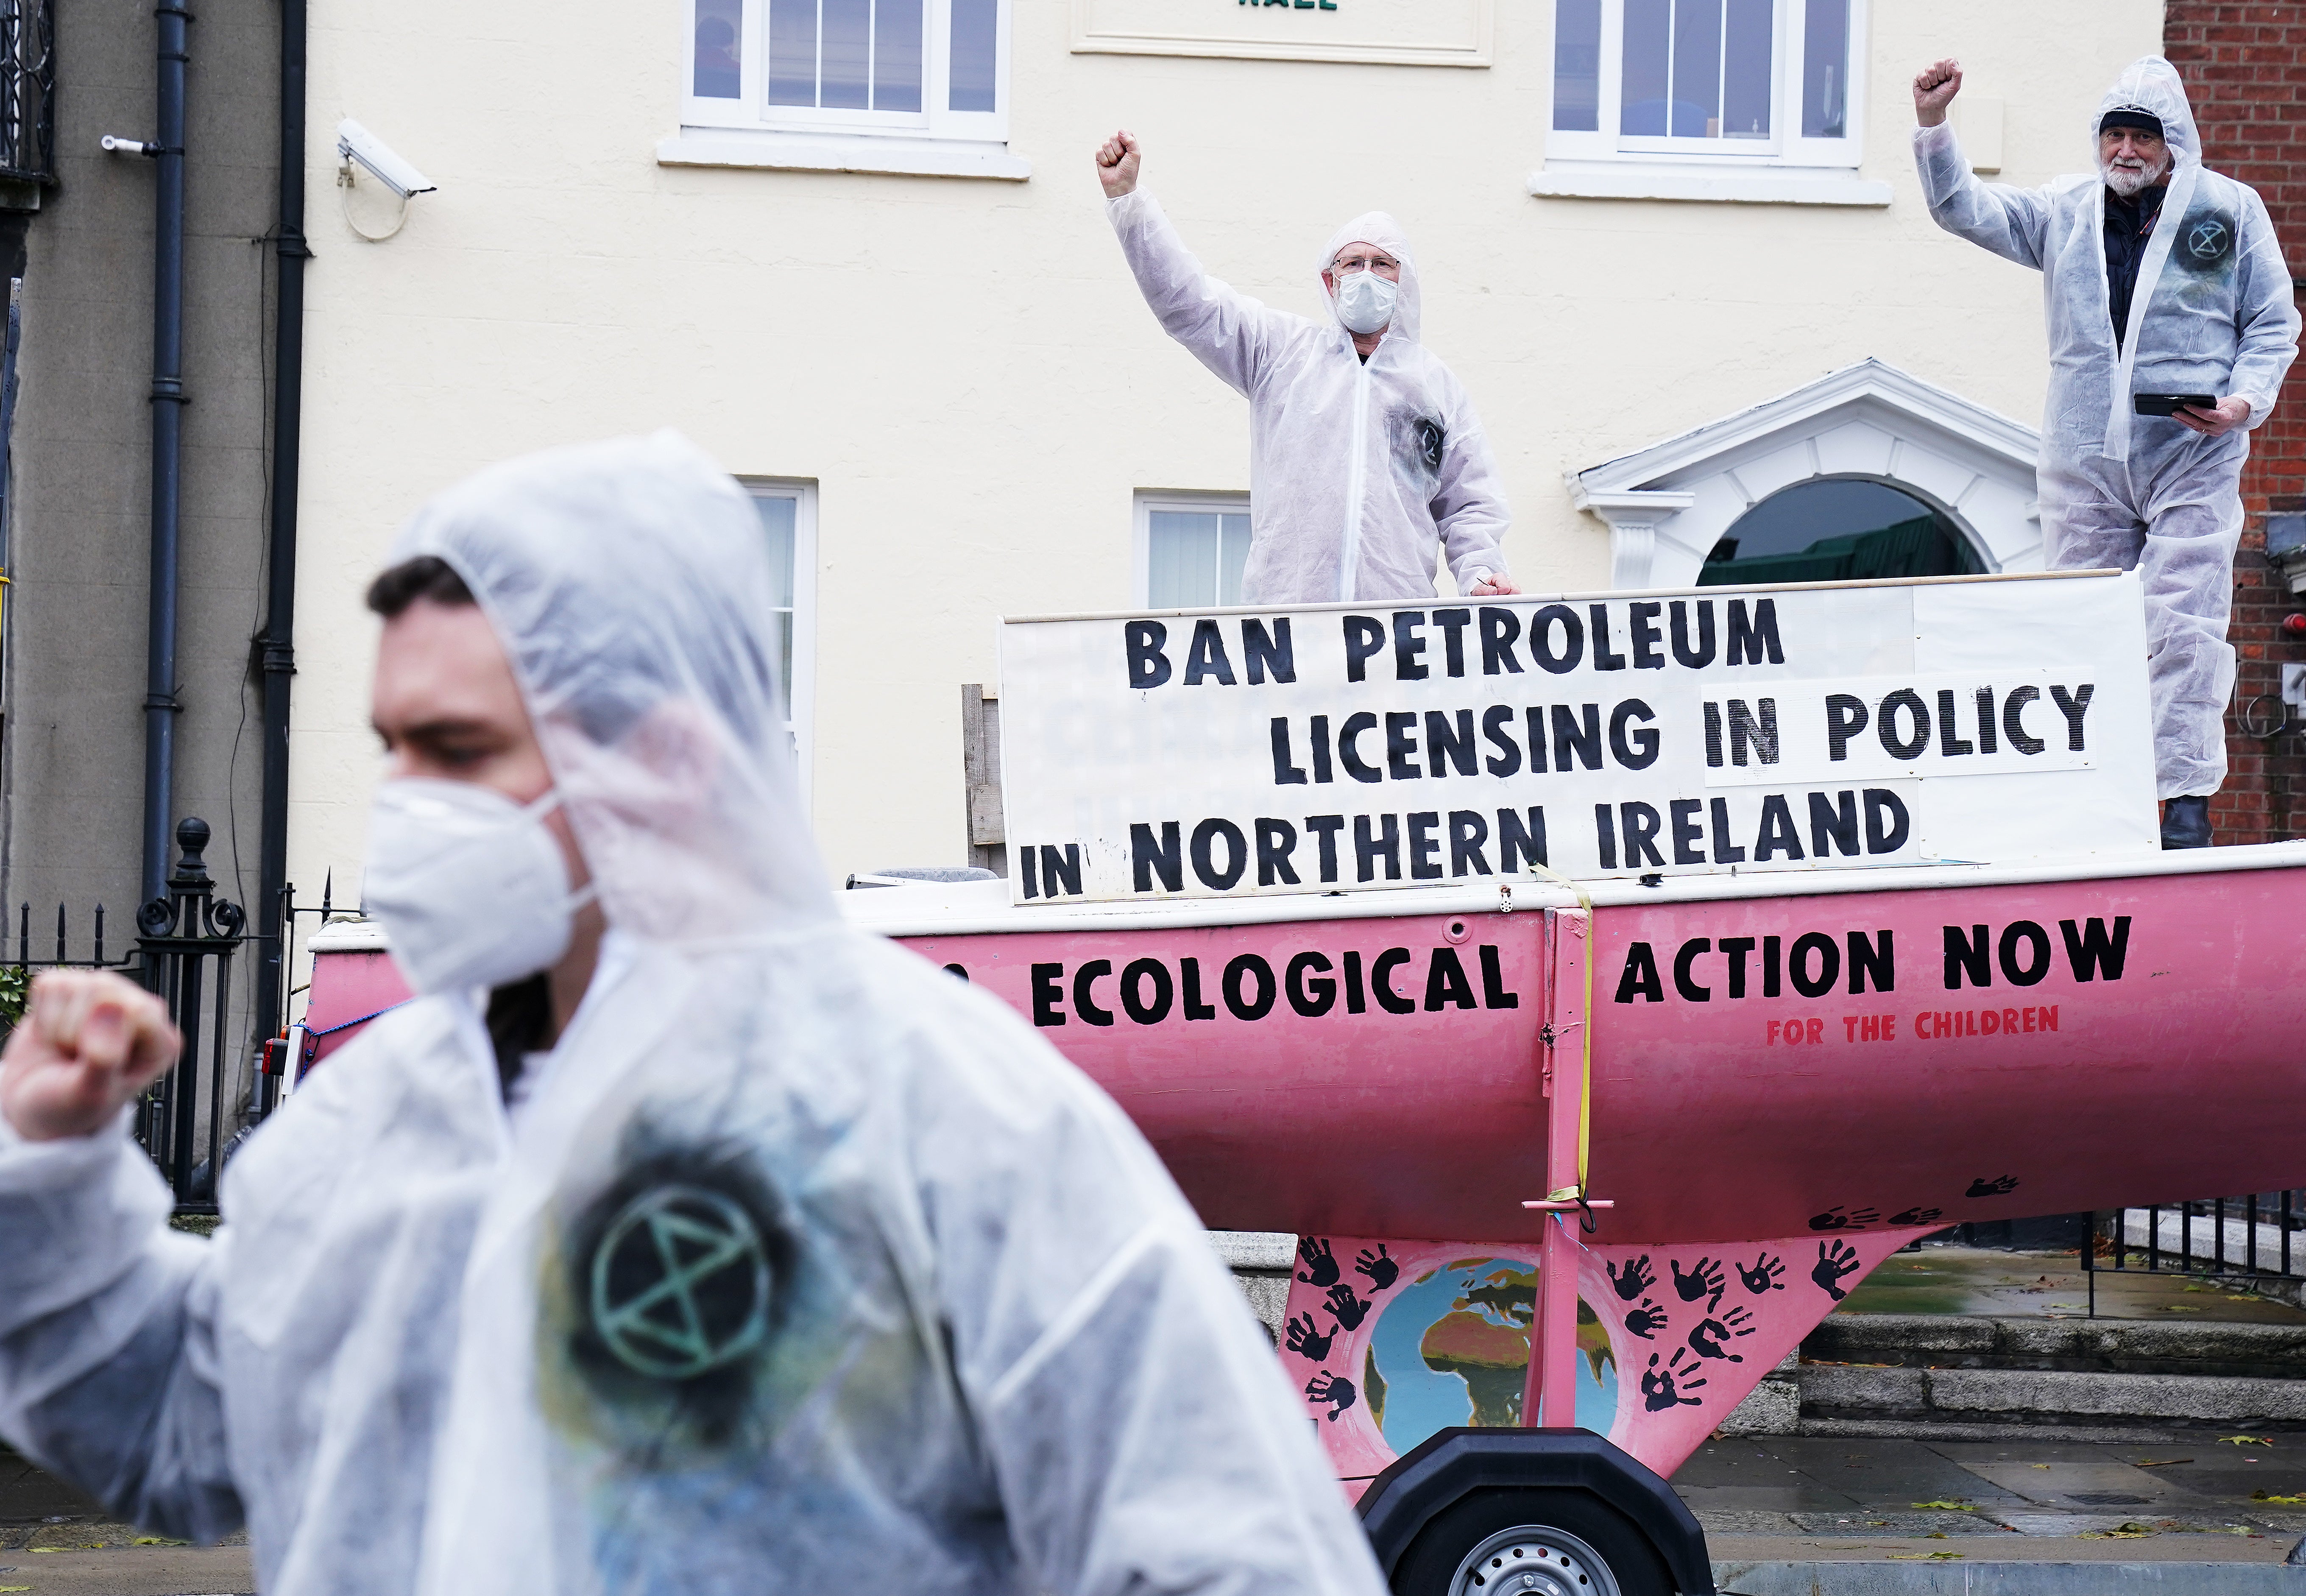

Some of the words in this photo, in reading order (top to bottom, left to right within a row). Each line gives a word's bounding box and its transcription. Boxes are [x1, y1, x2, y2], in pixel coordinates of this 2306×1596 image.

[1125, 617, 1296, 689] BAN
[1343, 598, 1785, 683] PETROLEUM
[1271, 698, 1660, 785] LICENSING
[1703, 698, 1779, 767] IN
[1825, 684, 2094, 760] POLICY
[1020, 843, 1083, 900] IN
[1129, 804, 1548, 893] NORTHERN
[1595, 788, 1910, 869] IRELAND
[1031, 942, 1519, 1027] ECOLOGICAL
[1614, 929, 1895, 1005] ACTION
[1942, 916, 2132, 990] NOW
[1766, 1018, 1824, 1046] FOR
[1843, 1014, 1896, 1043] THE
[1914, 1004, 2059, 1040] CHILDREN
